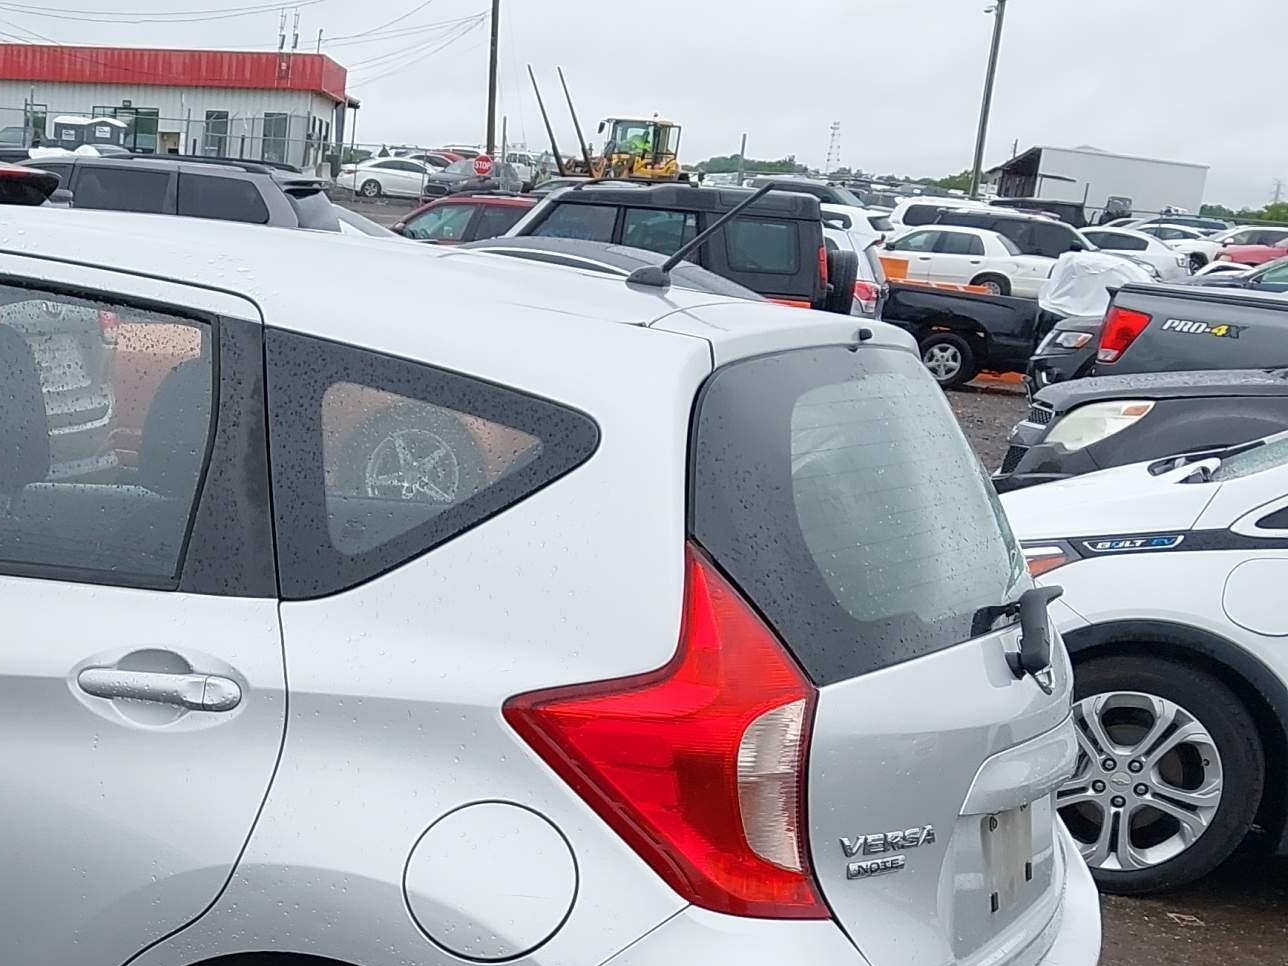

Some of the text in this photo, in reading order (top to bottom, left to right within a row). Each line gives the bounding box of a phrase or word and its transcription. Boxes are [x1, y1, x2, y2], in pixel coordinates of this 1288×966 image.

[475, 160, 491, 169] STOP
[1096, 539, 1146, 549] BOLT
[839, 824, 936, 857] VERSA
[857, 858, 902, 876] NOTE
